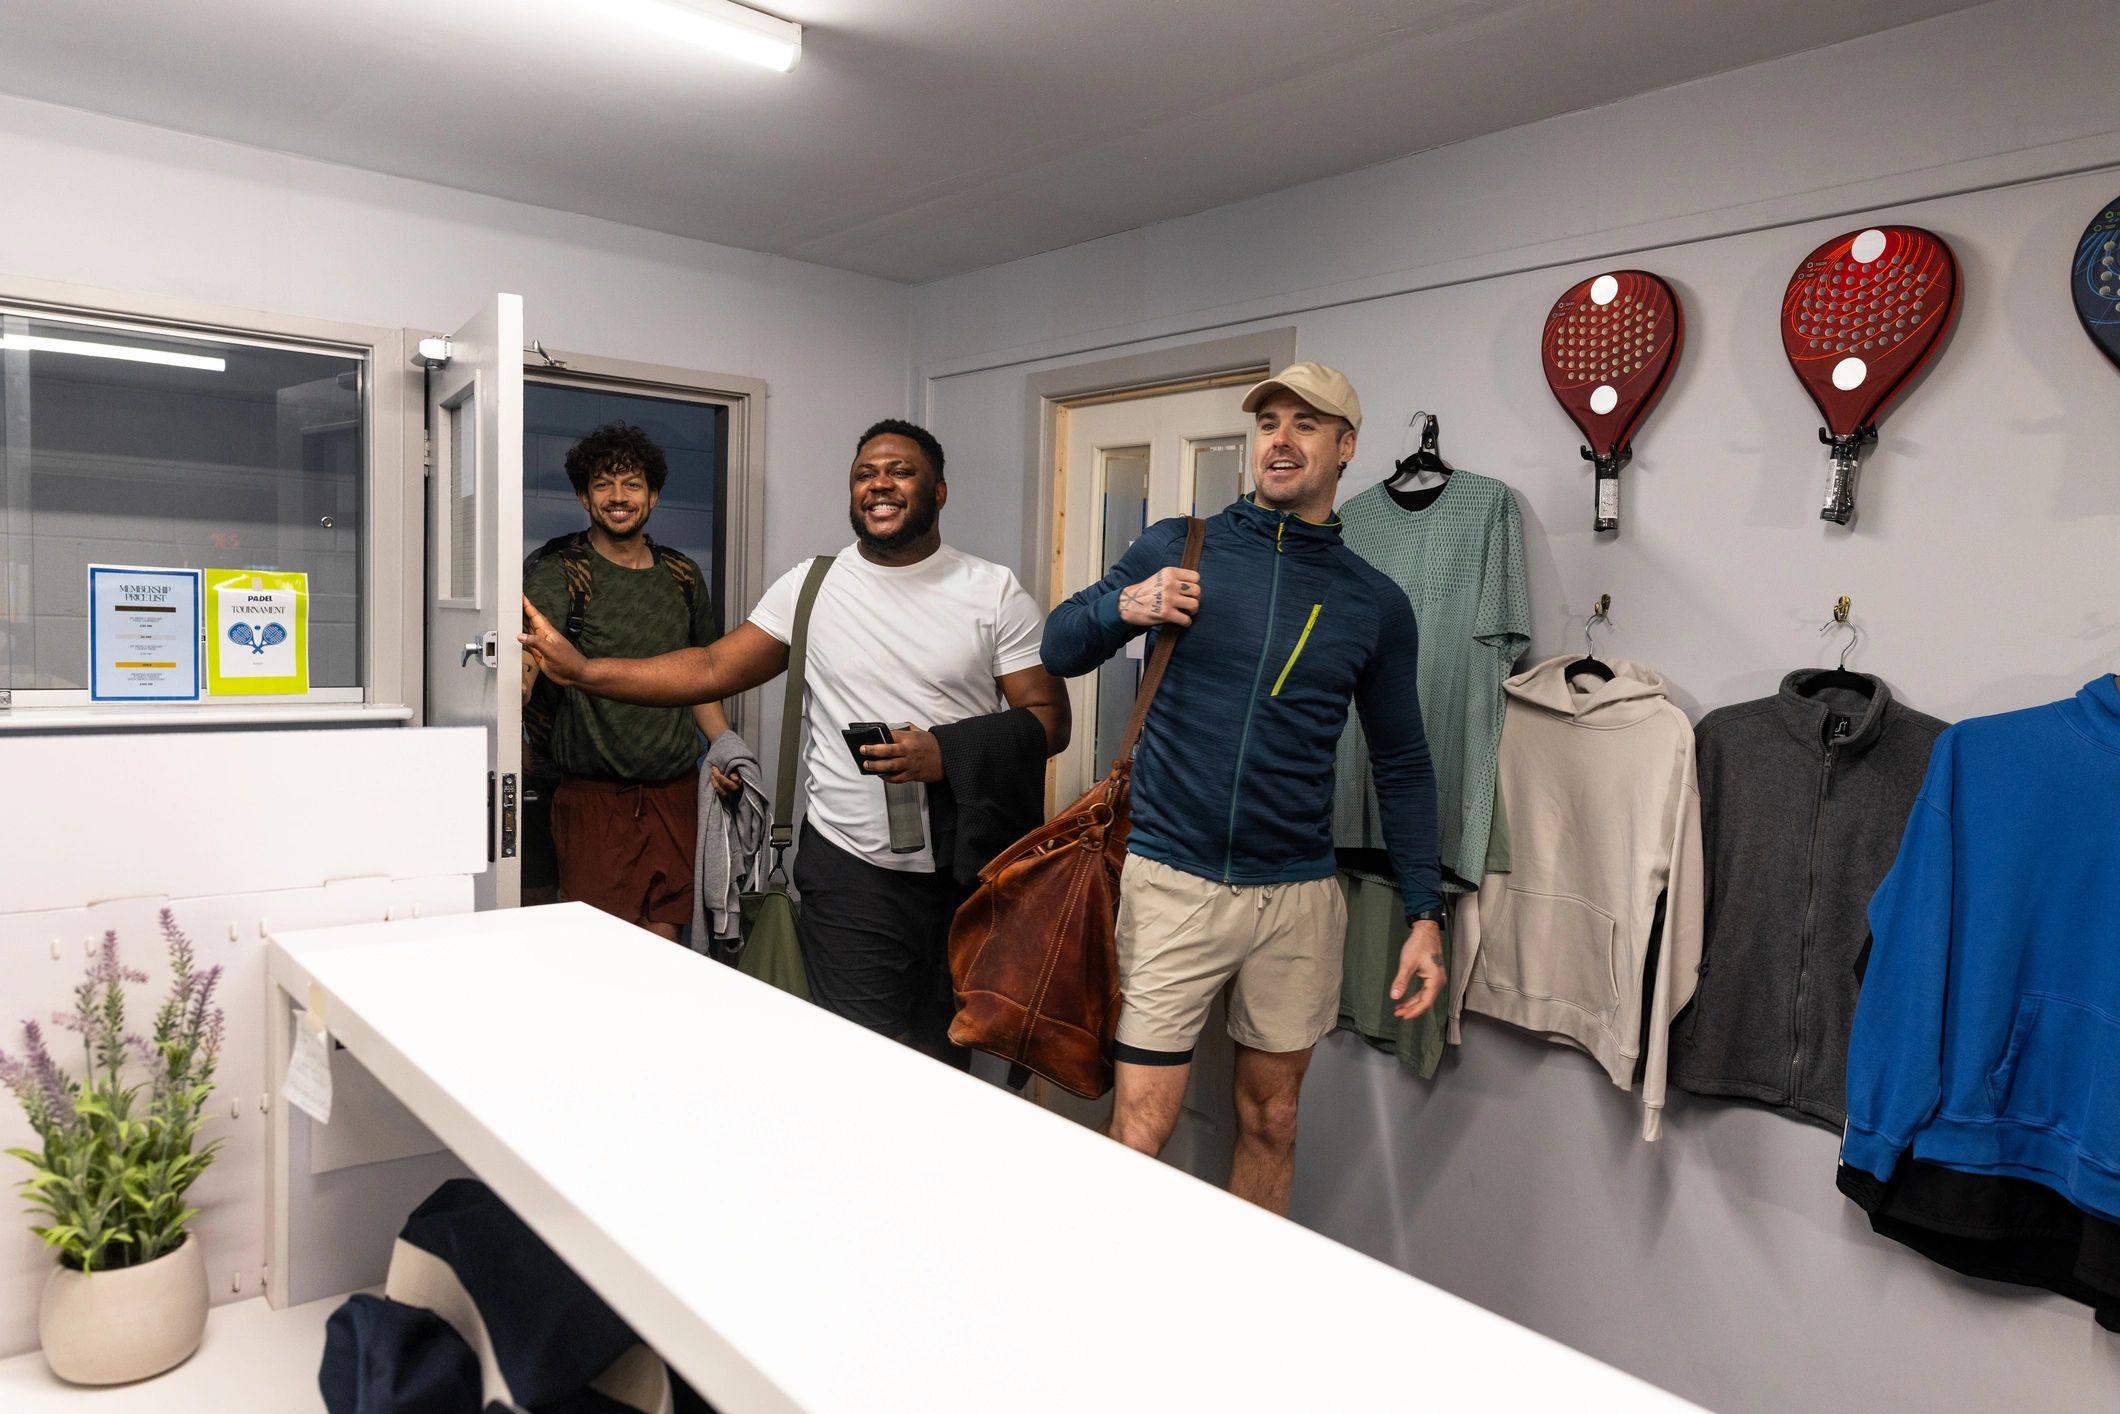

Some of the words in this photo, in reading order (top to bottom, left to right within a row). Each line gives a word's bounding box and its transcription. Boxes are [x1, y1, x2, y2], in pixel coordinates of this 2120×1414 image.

[119, 585, 172, 594] MEMBERSHIP
[125, 593, 146, 601] PRICE
[149, 594, 167, 602] LIST
[231, 605, 286, 614] TOURNAMENT
